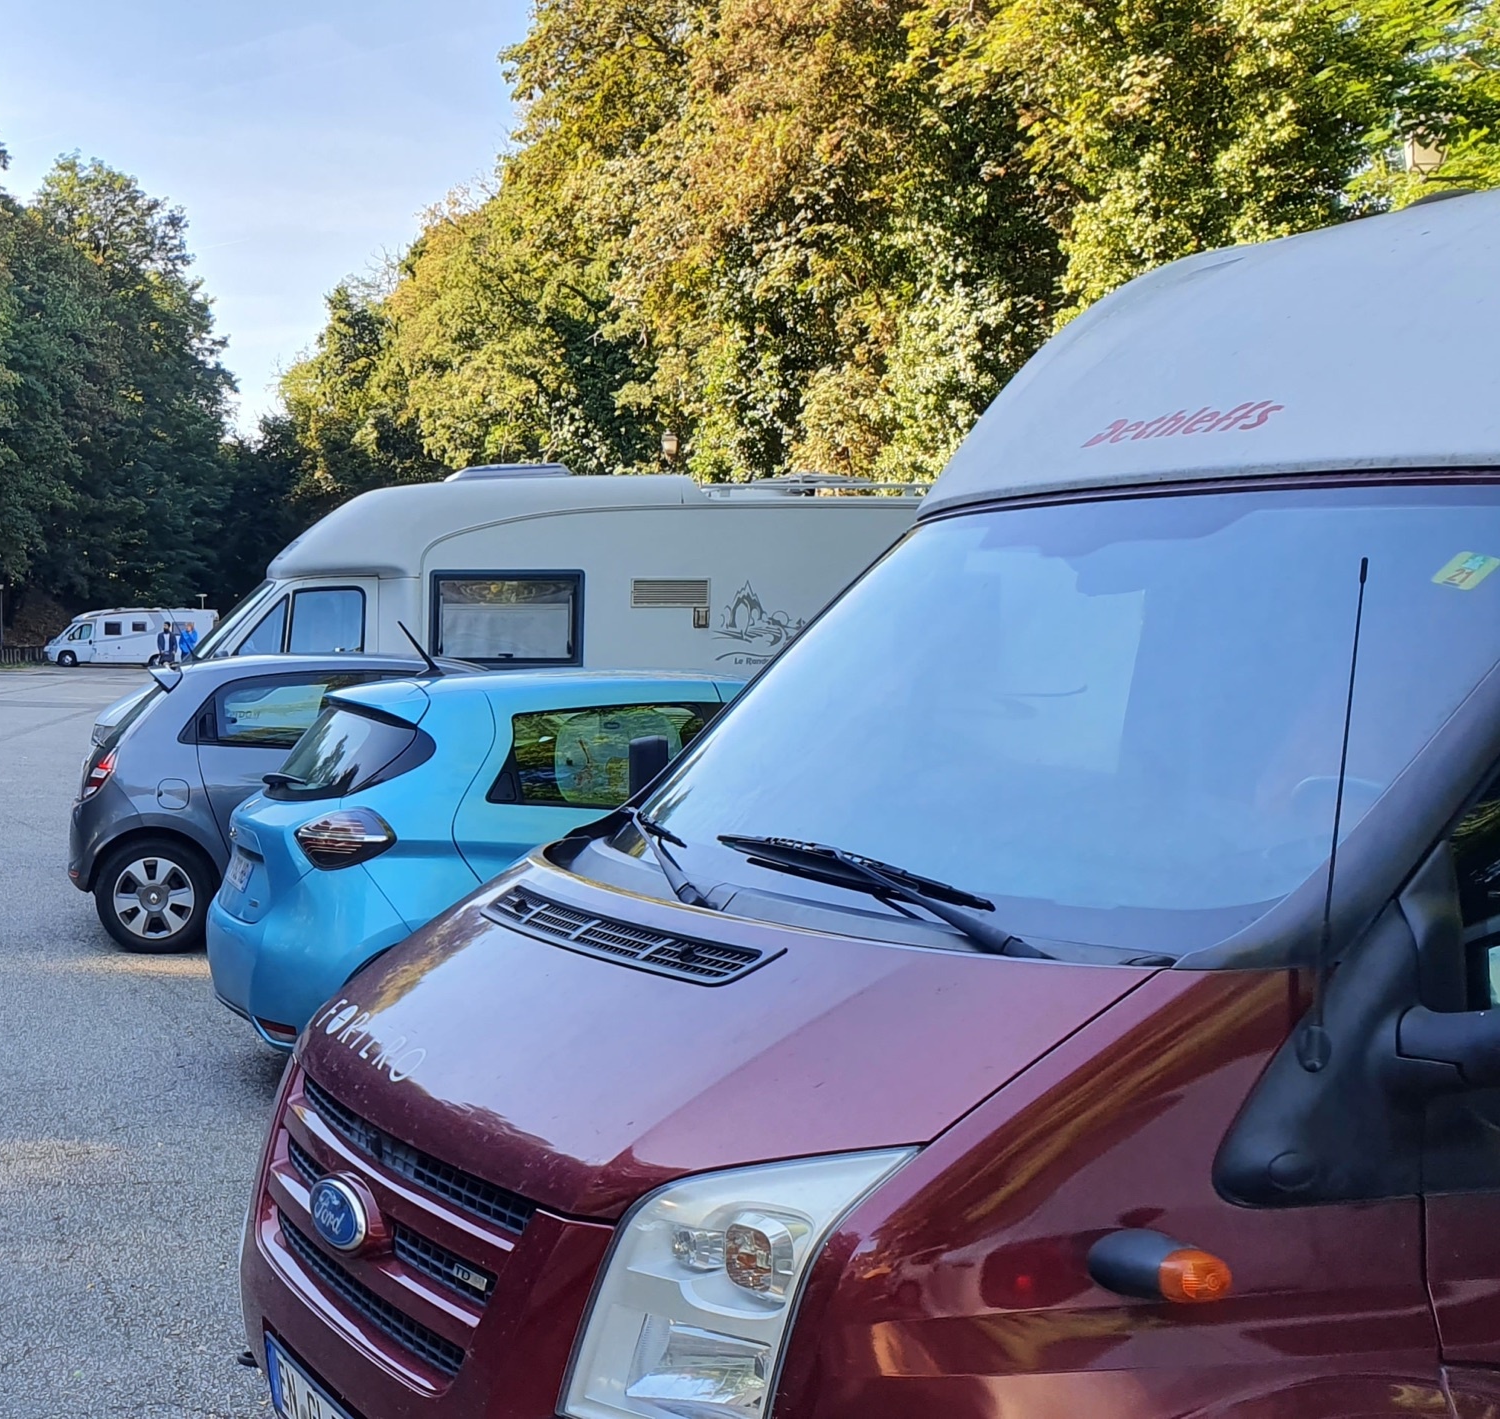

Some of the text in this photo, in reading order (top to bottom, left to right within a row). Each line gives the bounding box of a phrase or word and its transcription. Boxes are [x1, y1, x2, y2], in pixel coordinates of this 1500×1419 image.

[1446, 568, 1474, 584] 21
[314, 1189, 346, 1235] Ford
[455, 1264, 471, 1281] TD
